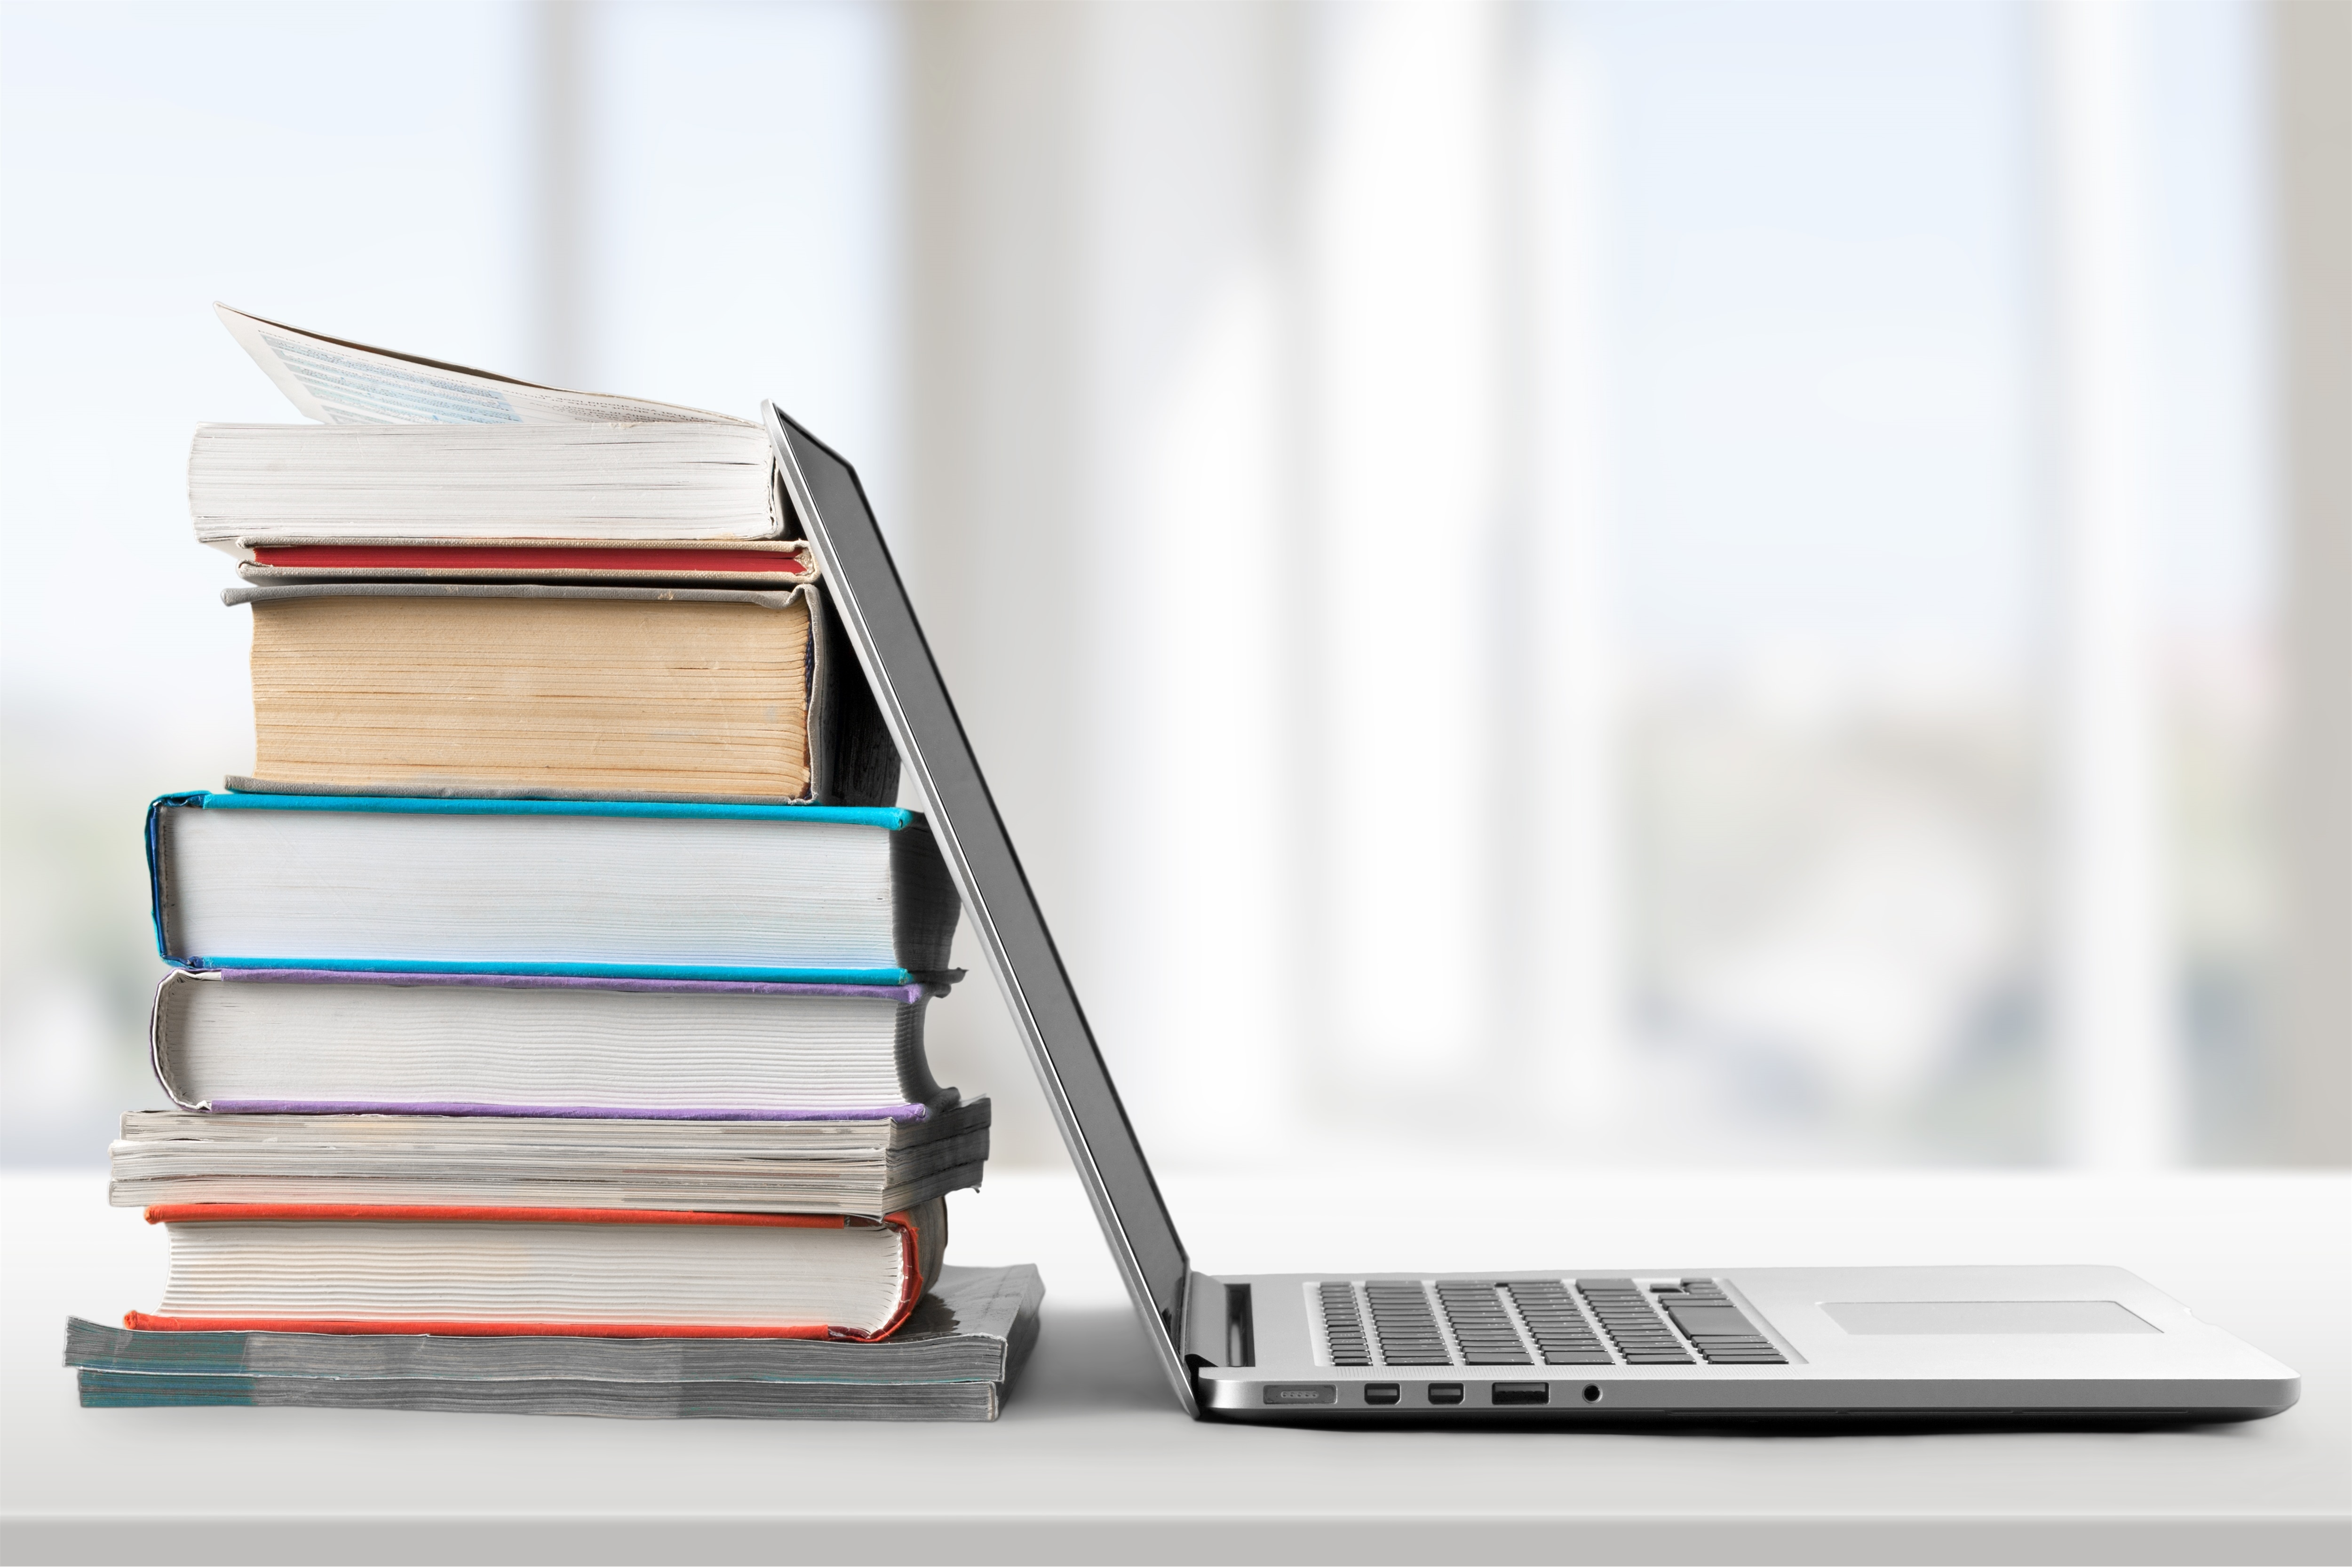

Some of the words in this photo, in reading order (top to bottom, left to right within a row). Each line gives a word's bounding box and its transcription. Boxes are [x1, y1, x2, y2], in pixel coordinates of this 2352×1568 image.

[257, 329, 301, 344] related
[413, 371, 467, 383] different
[502, 390, 545, 399] picture
